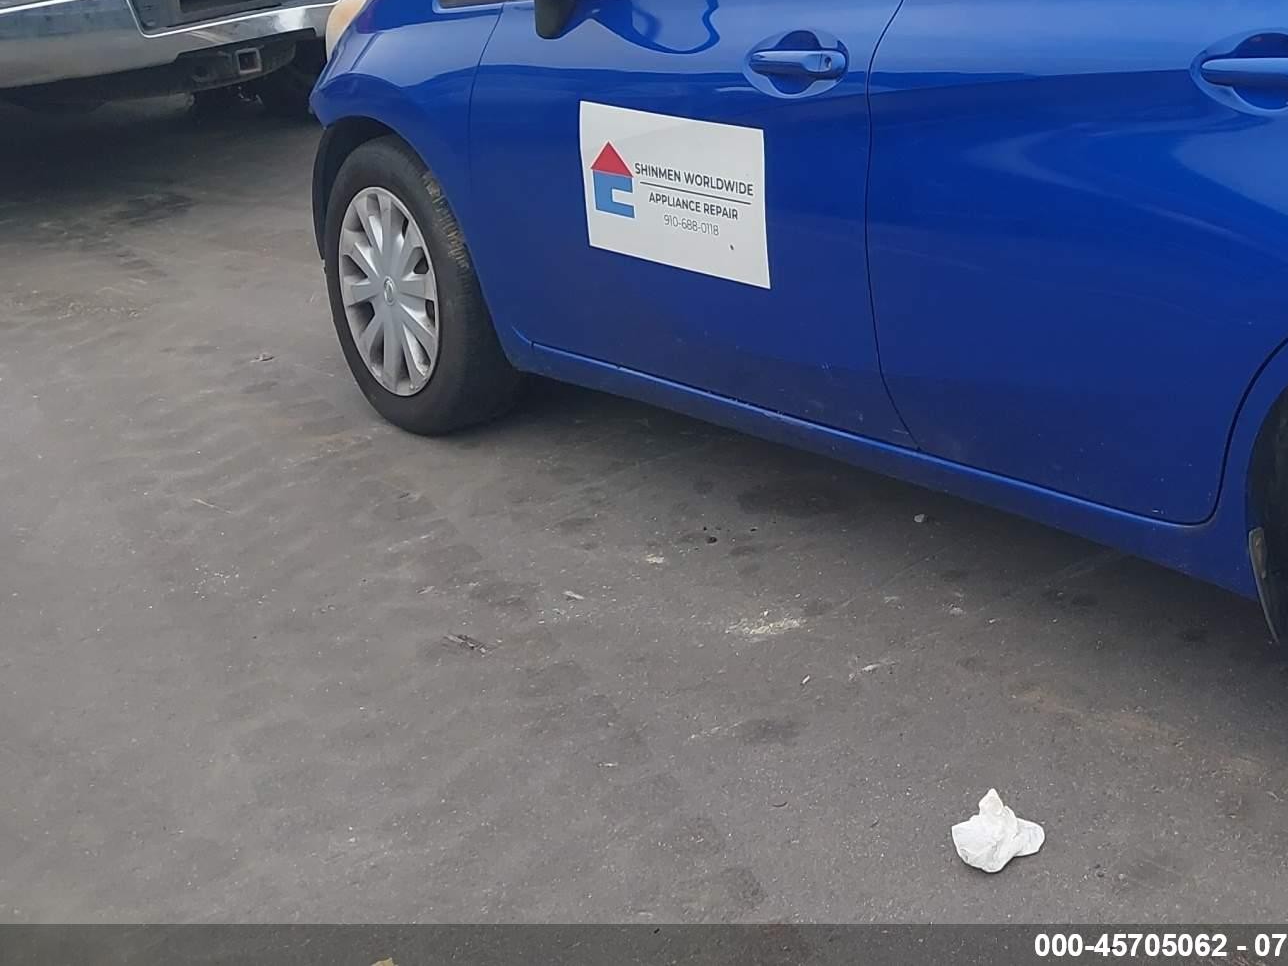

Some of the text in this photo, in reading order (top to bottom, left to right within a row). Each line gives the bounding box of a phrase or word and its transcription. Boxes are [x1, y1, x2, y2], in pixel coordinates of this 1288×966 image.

[634, 162, 754, 197] SHINMEN WORLDWIDE
[648, 191, 738, 220] APPLIANCE REPAIR
[663, 214, 719, 236] 910-688-0118
